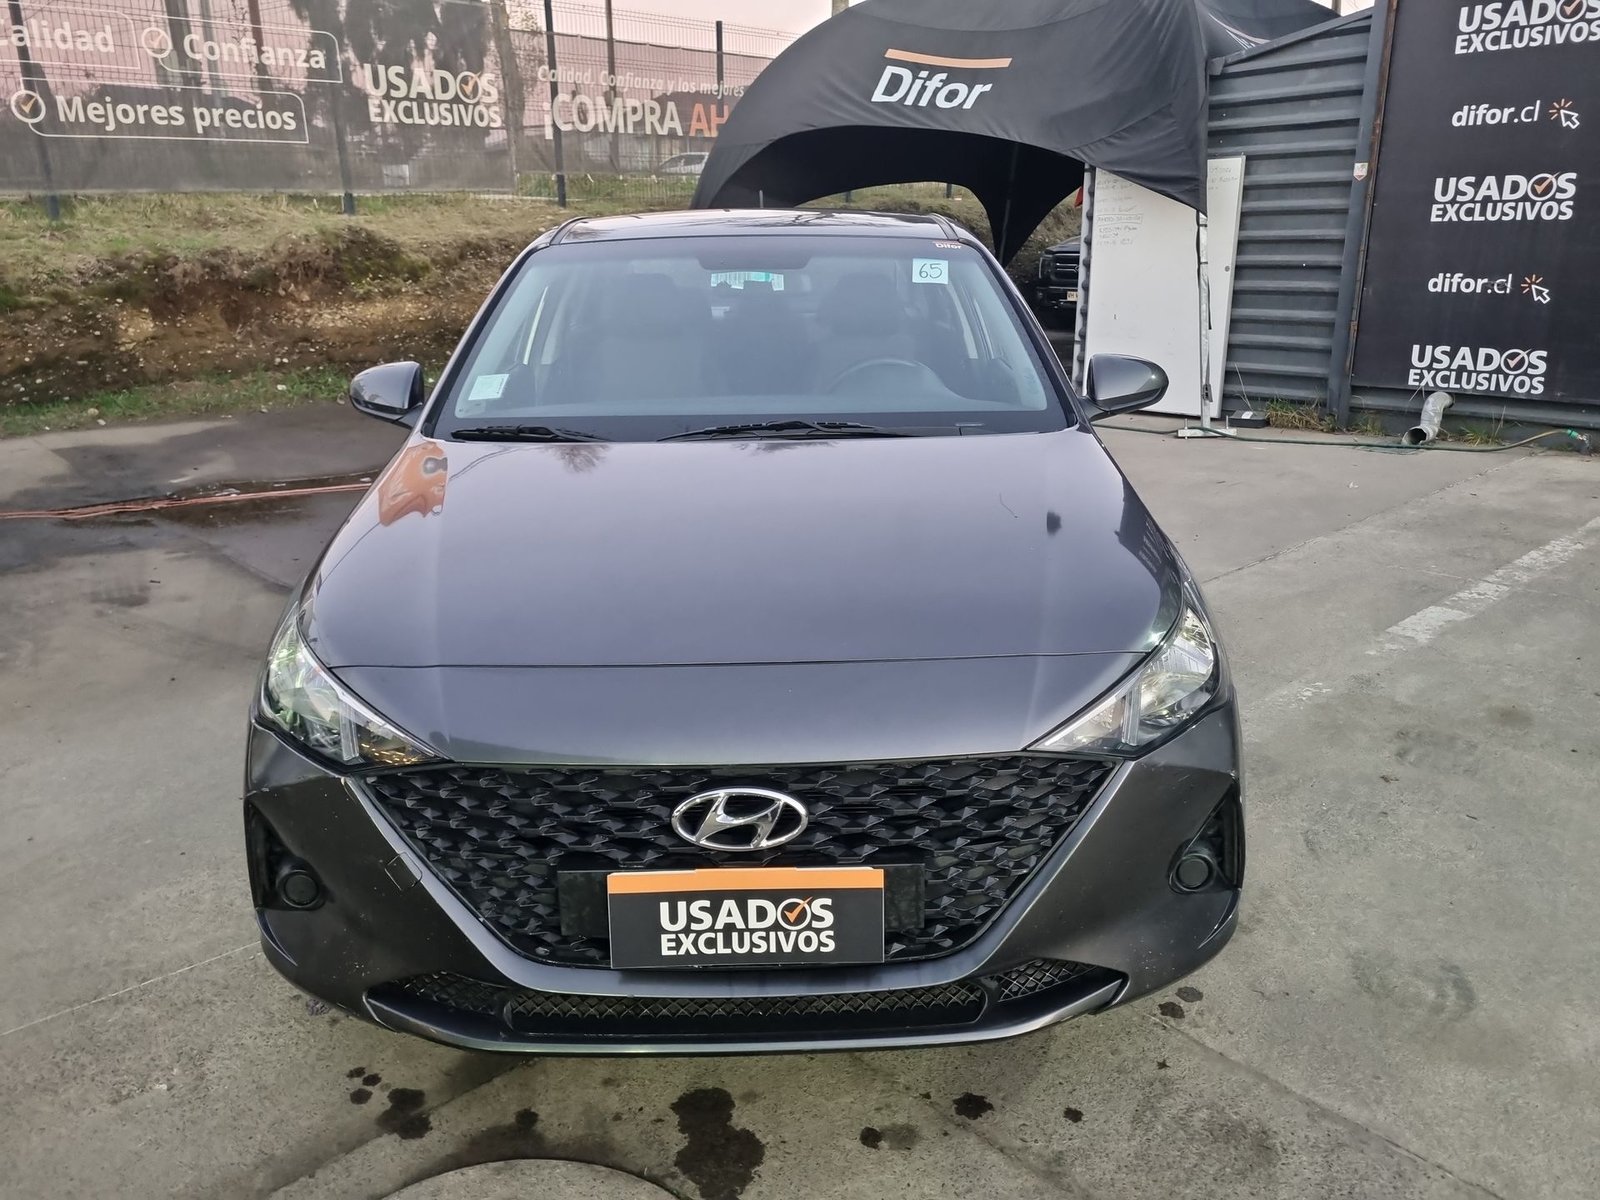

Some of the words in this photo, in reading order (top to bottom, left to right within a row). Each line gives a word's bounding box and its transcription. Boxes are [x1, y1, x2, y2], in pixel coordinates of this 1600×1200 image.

[1458, 0, 1600, 33] USADOS
[183, 33, 326, 69] Confianza
[1454, 20, 1600, 55] EXCLUSIVOS
[364, 63, 499, 104] USADOS
[600, 69, 664, 92] Confianza
[667, 80, 675, 96] y
[677, 77, 697, 94] los
[699, 80, 745, 100] mejores
[871, 65, 993, 109] Difor
[55, 95, 186, 132] Mejores
[193, 105, 297, 133] precios
[368, 99, 502, 129] EXCLUSIVOS
[1451, 99, 1541, 127] difor.cl
[1433, 171, 1578, 203] USADOS
[1430, 200, 1575, 223] EXCLUSIVOS
[918, 262, 943, 280] 65
[1427, 272, 1513, 294] difor.cl
[1410, 344, 1549, 376] USADOS
[1407, 368, 1546, 395] EXCLUSIVOS
[659, 896, 835, 932] USADOS
[660, 930, 836, 956] EXCLUSIVOS
